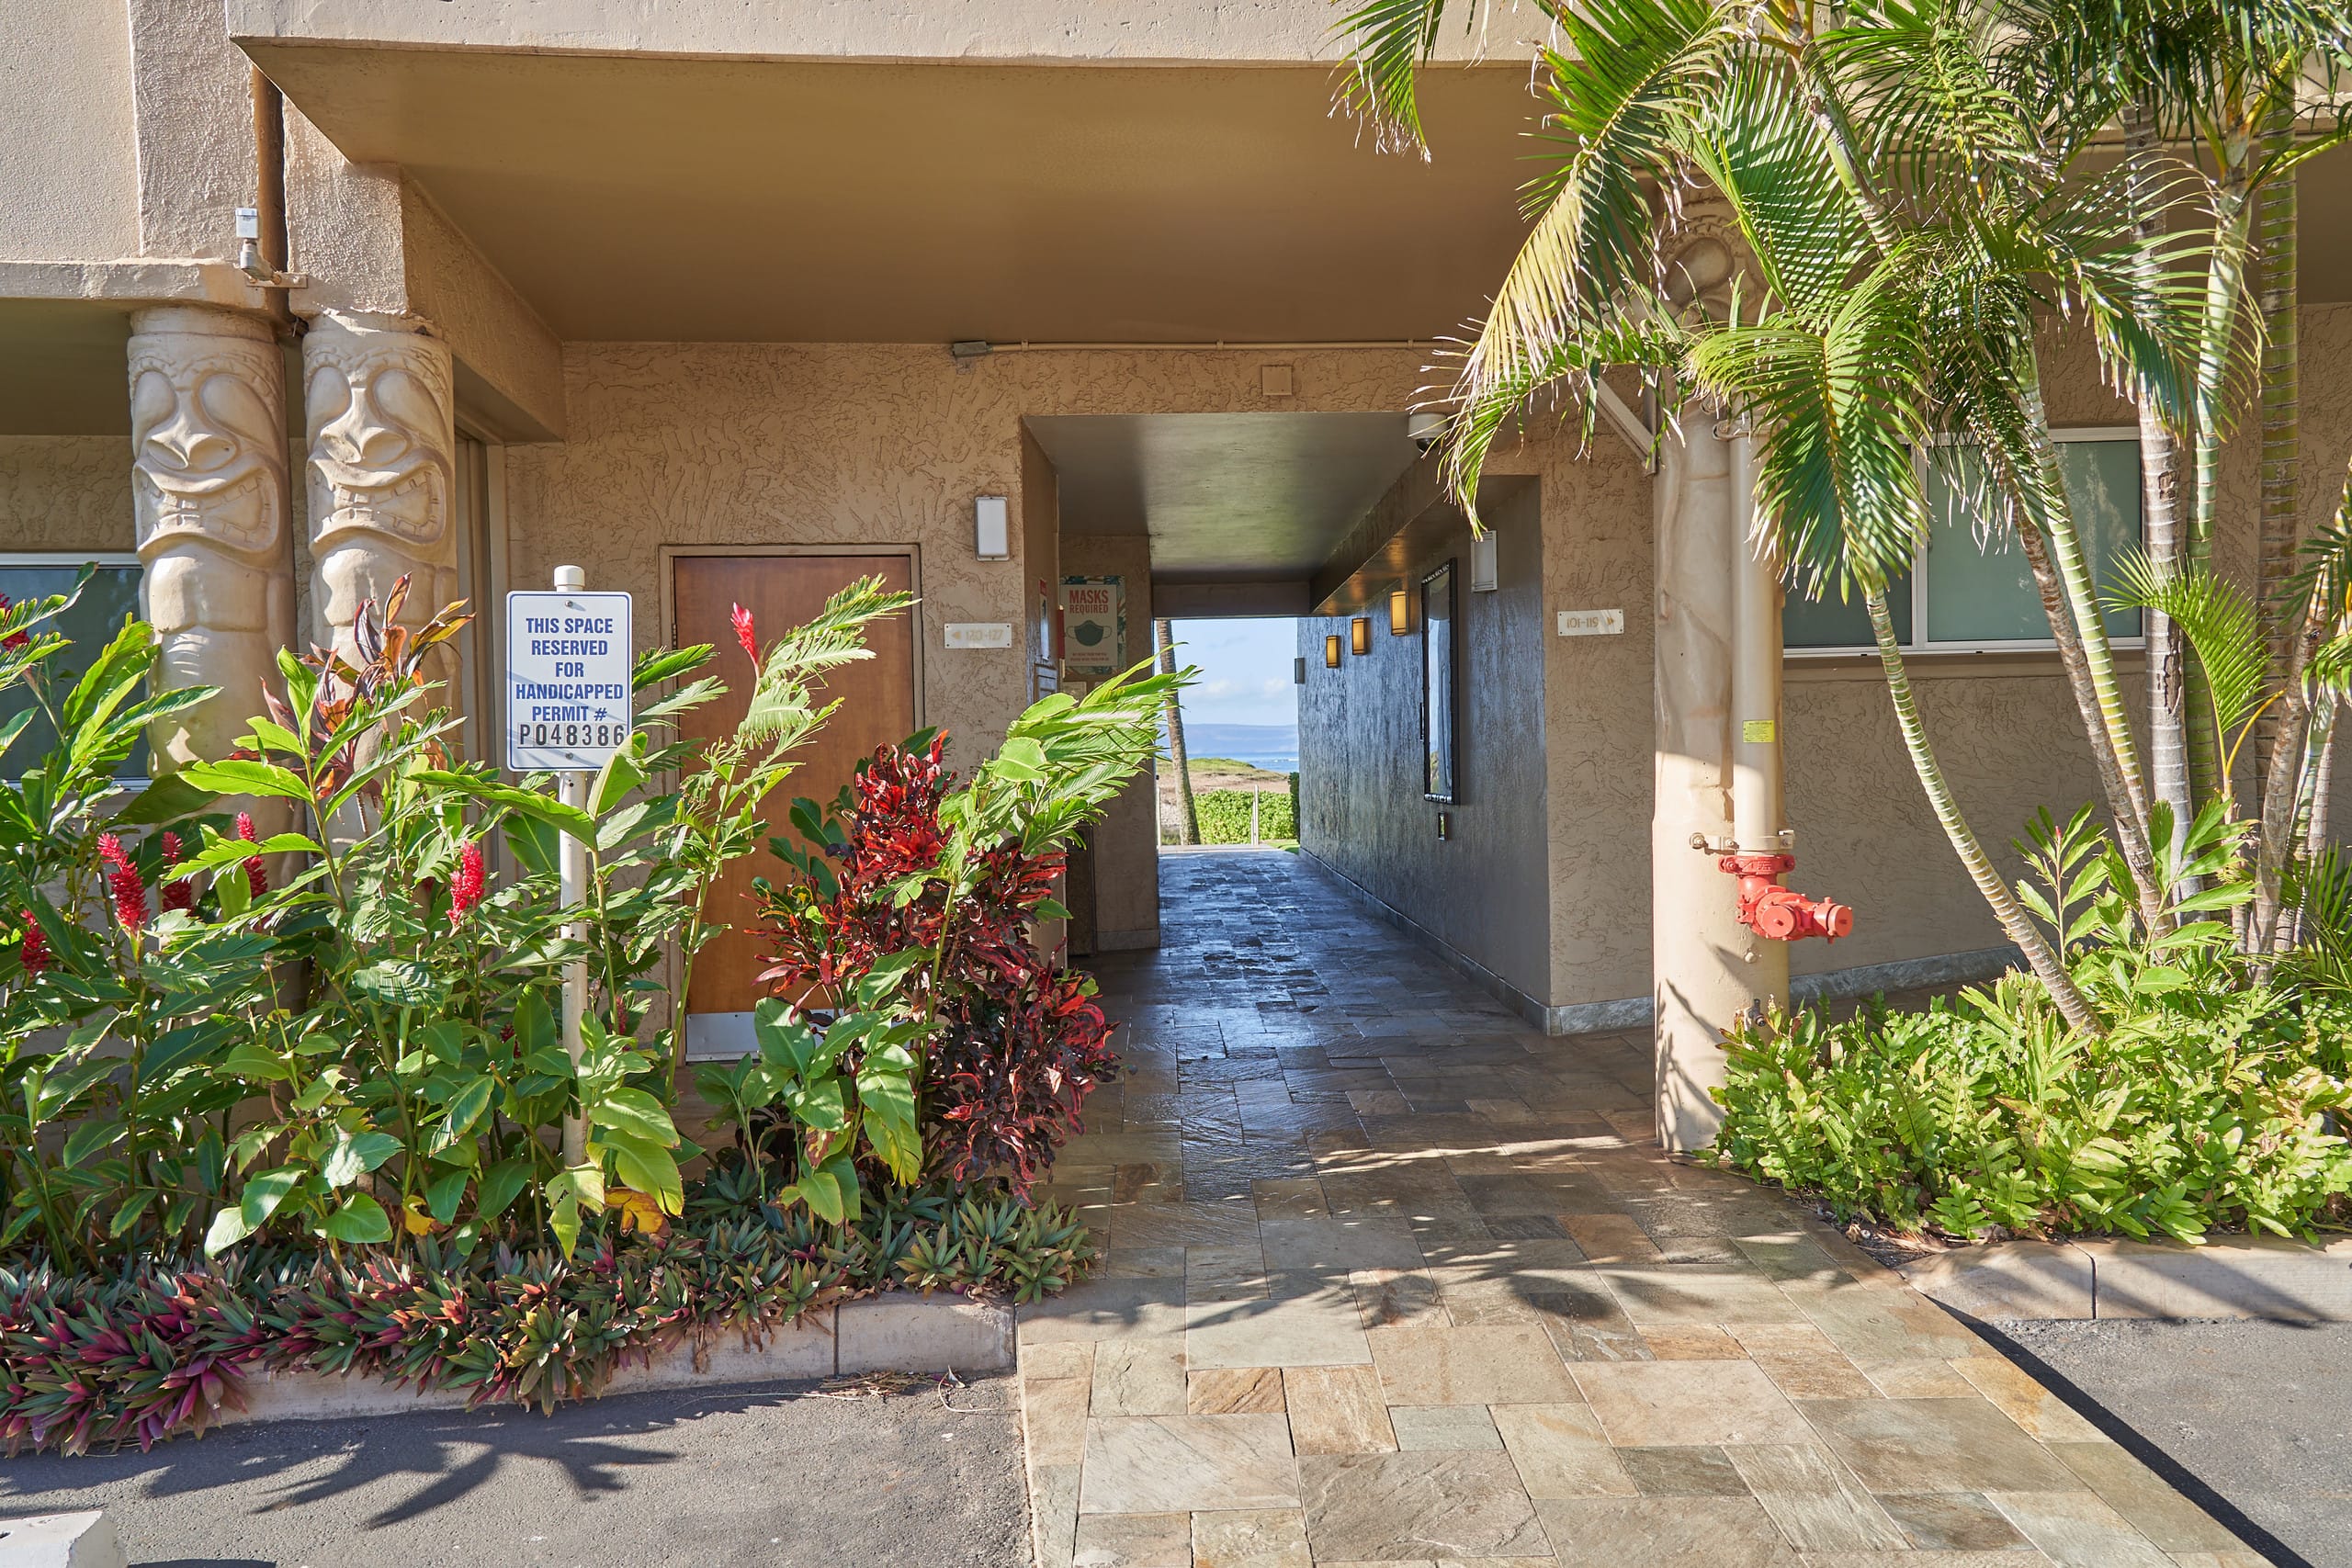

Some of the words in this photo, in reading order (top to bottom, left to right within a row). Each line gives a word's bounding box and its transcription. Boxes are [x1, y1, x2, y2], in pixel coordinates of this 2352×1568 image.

[1069, 590, 1108, 604] MASKS
[1069, 604, 1108, 615] REQUIRED
[526, 618, 560, 634] THIS
[564, 618, 613, 634] SPACE
[1566, 616, 1599, 628] 101-119
[531, 640, 608, 655] RESERVED
[555, 662, 584, 677] FOR
[515, 683, 624, 699] HANDICAPPED
[532, 706, 589, 721] PERMIT
[594, 707, 607, 721] #
